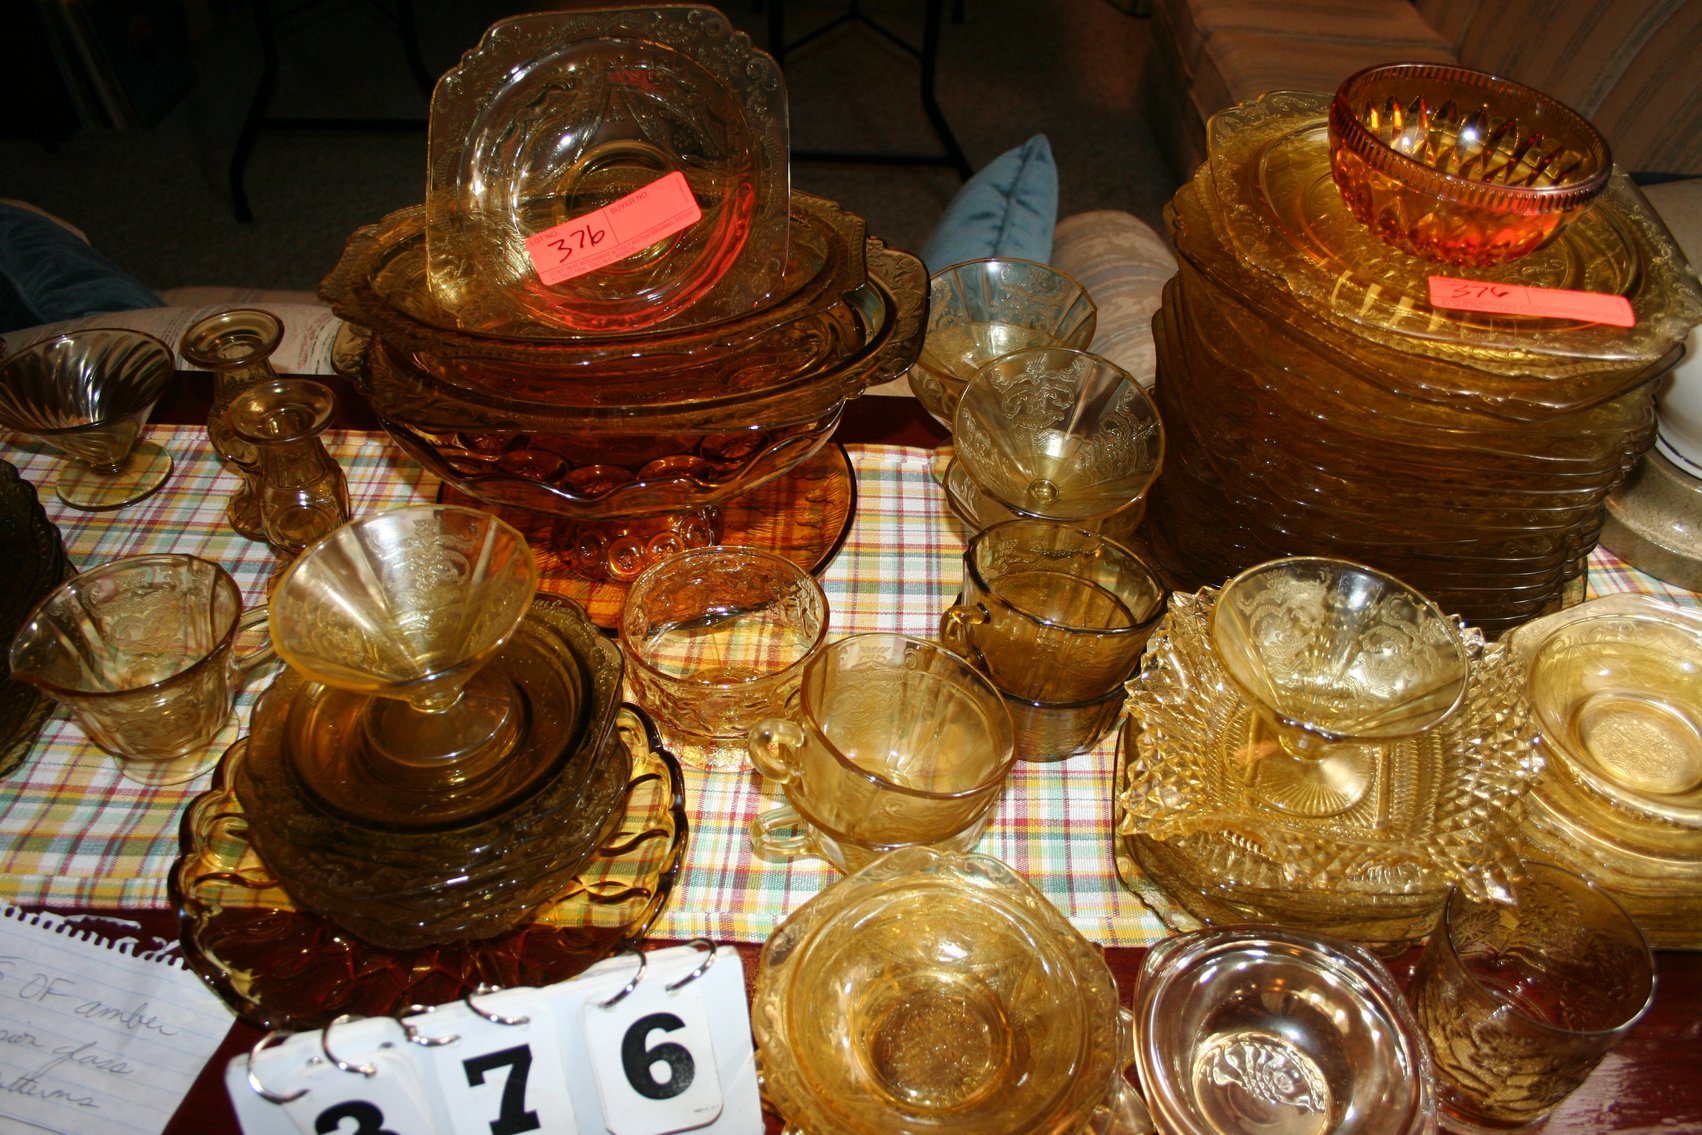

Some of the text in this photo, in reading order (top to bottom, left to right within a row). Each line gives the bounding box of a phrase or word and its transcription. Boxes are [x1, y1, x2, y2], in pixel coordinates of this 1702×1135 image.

[610, 191, 648, 214] BUYER NO
[530, 231, 557, 246] LOT NO
[547, 224, 605, 263] 376
[19, 973, 177, 1036] OF amber
[36, 1041, 134, 1077] glass
[462, 1011, 695, 1135] 7 6
[0, 1070, 99, 1109] tterns
